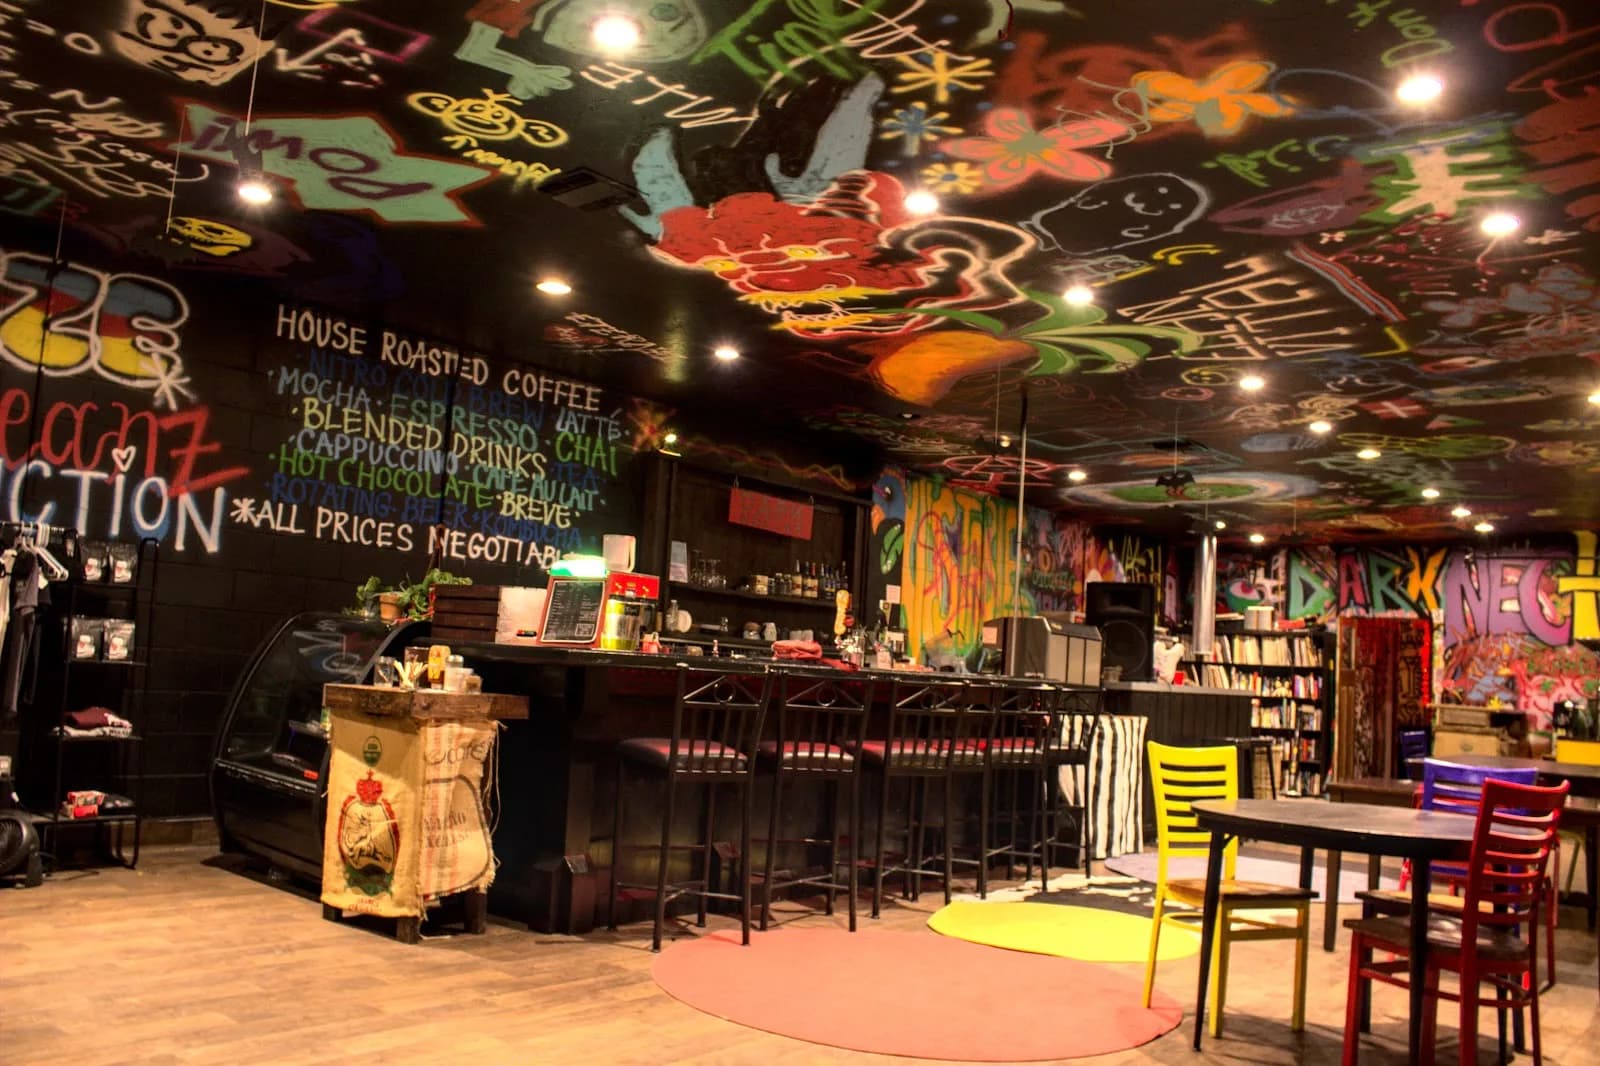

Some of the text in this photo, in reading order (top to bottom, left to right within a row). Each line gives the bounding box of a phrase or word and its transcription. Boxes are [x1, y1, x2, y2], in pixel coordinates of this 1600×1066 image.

[276, 303, 602, 412] HOUSE ROASTED COFFEE
[277, 365, 371, 410] MOCHA
[391, 393, 539, 452] ESPRESSO
[303, 397, 618, 481] BLENDED DRINKS CHAI
[279, 443, 333, 481] HOT
[338, 457, 493, 509] CHOCOLATE
[297, 428, 459, 475] CAPPUCCINO
[530, 474, 557, 502] AU
[271, 472, 393, 517] ROTATING
[480, 511, 582, 548] KOMBUCHA
[315, 505, 413, 551] PRICES
[1288, 547, 1449, 621] DARK
